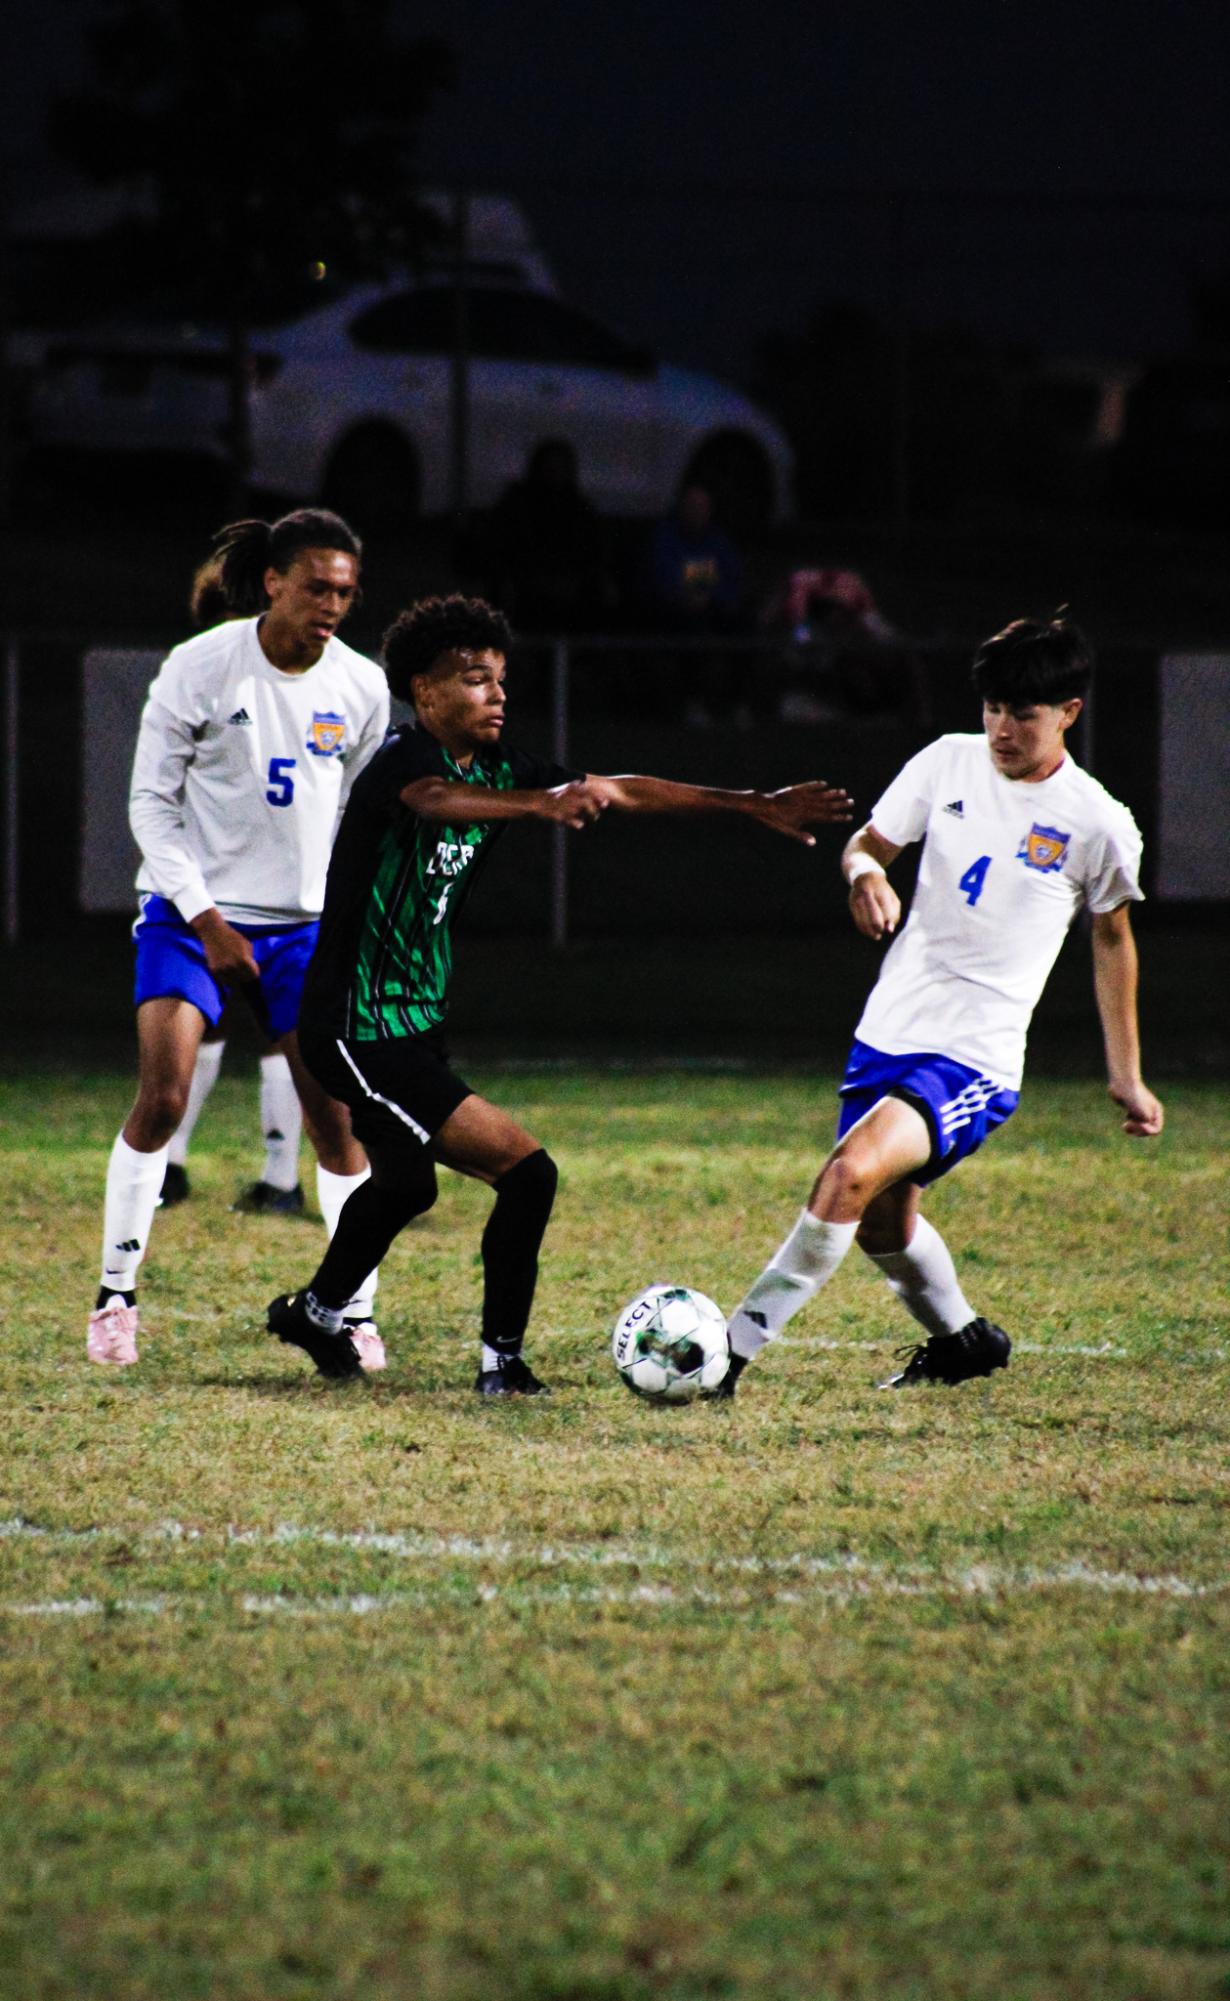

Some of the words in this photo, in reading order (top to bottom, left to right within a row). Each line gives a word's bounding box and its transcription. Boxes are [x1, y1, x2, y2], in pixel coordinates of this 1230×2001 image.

[266, 757, 297, 808] 5
[958, 855, 993, 907] 4
[616, 1300, 653, 1361] SELECT
